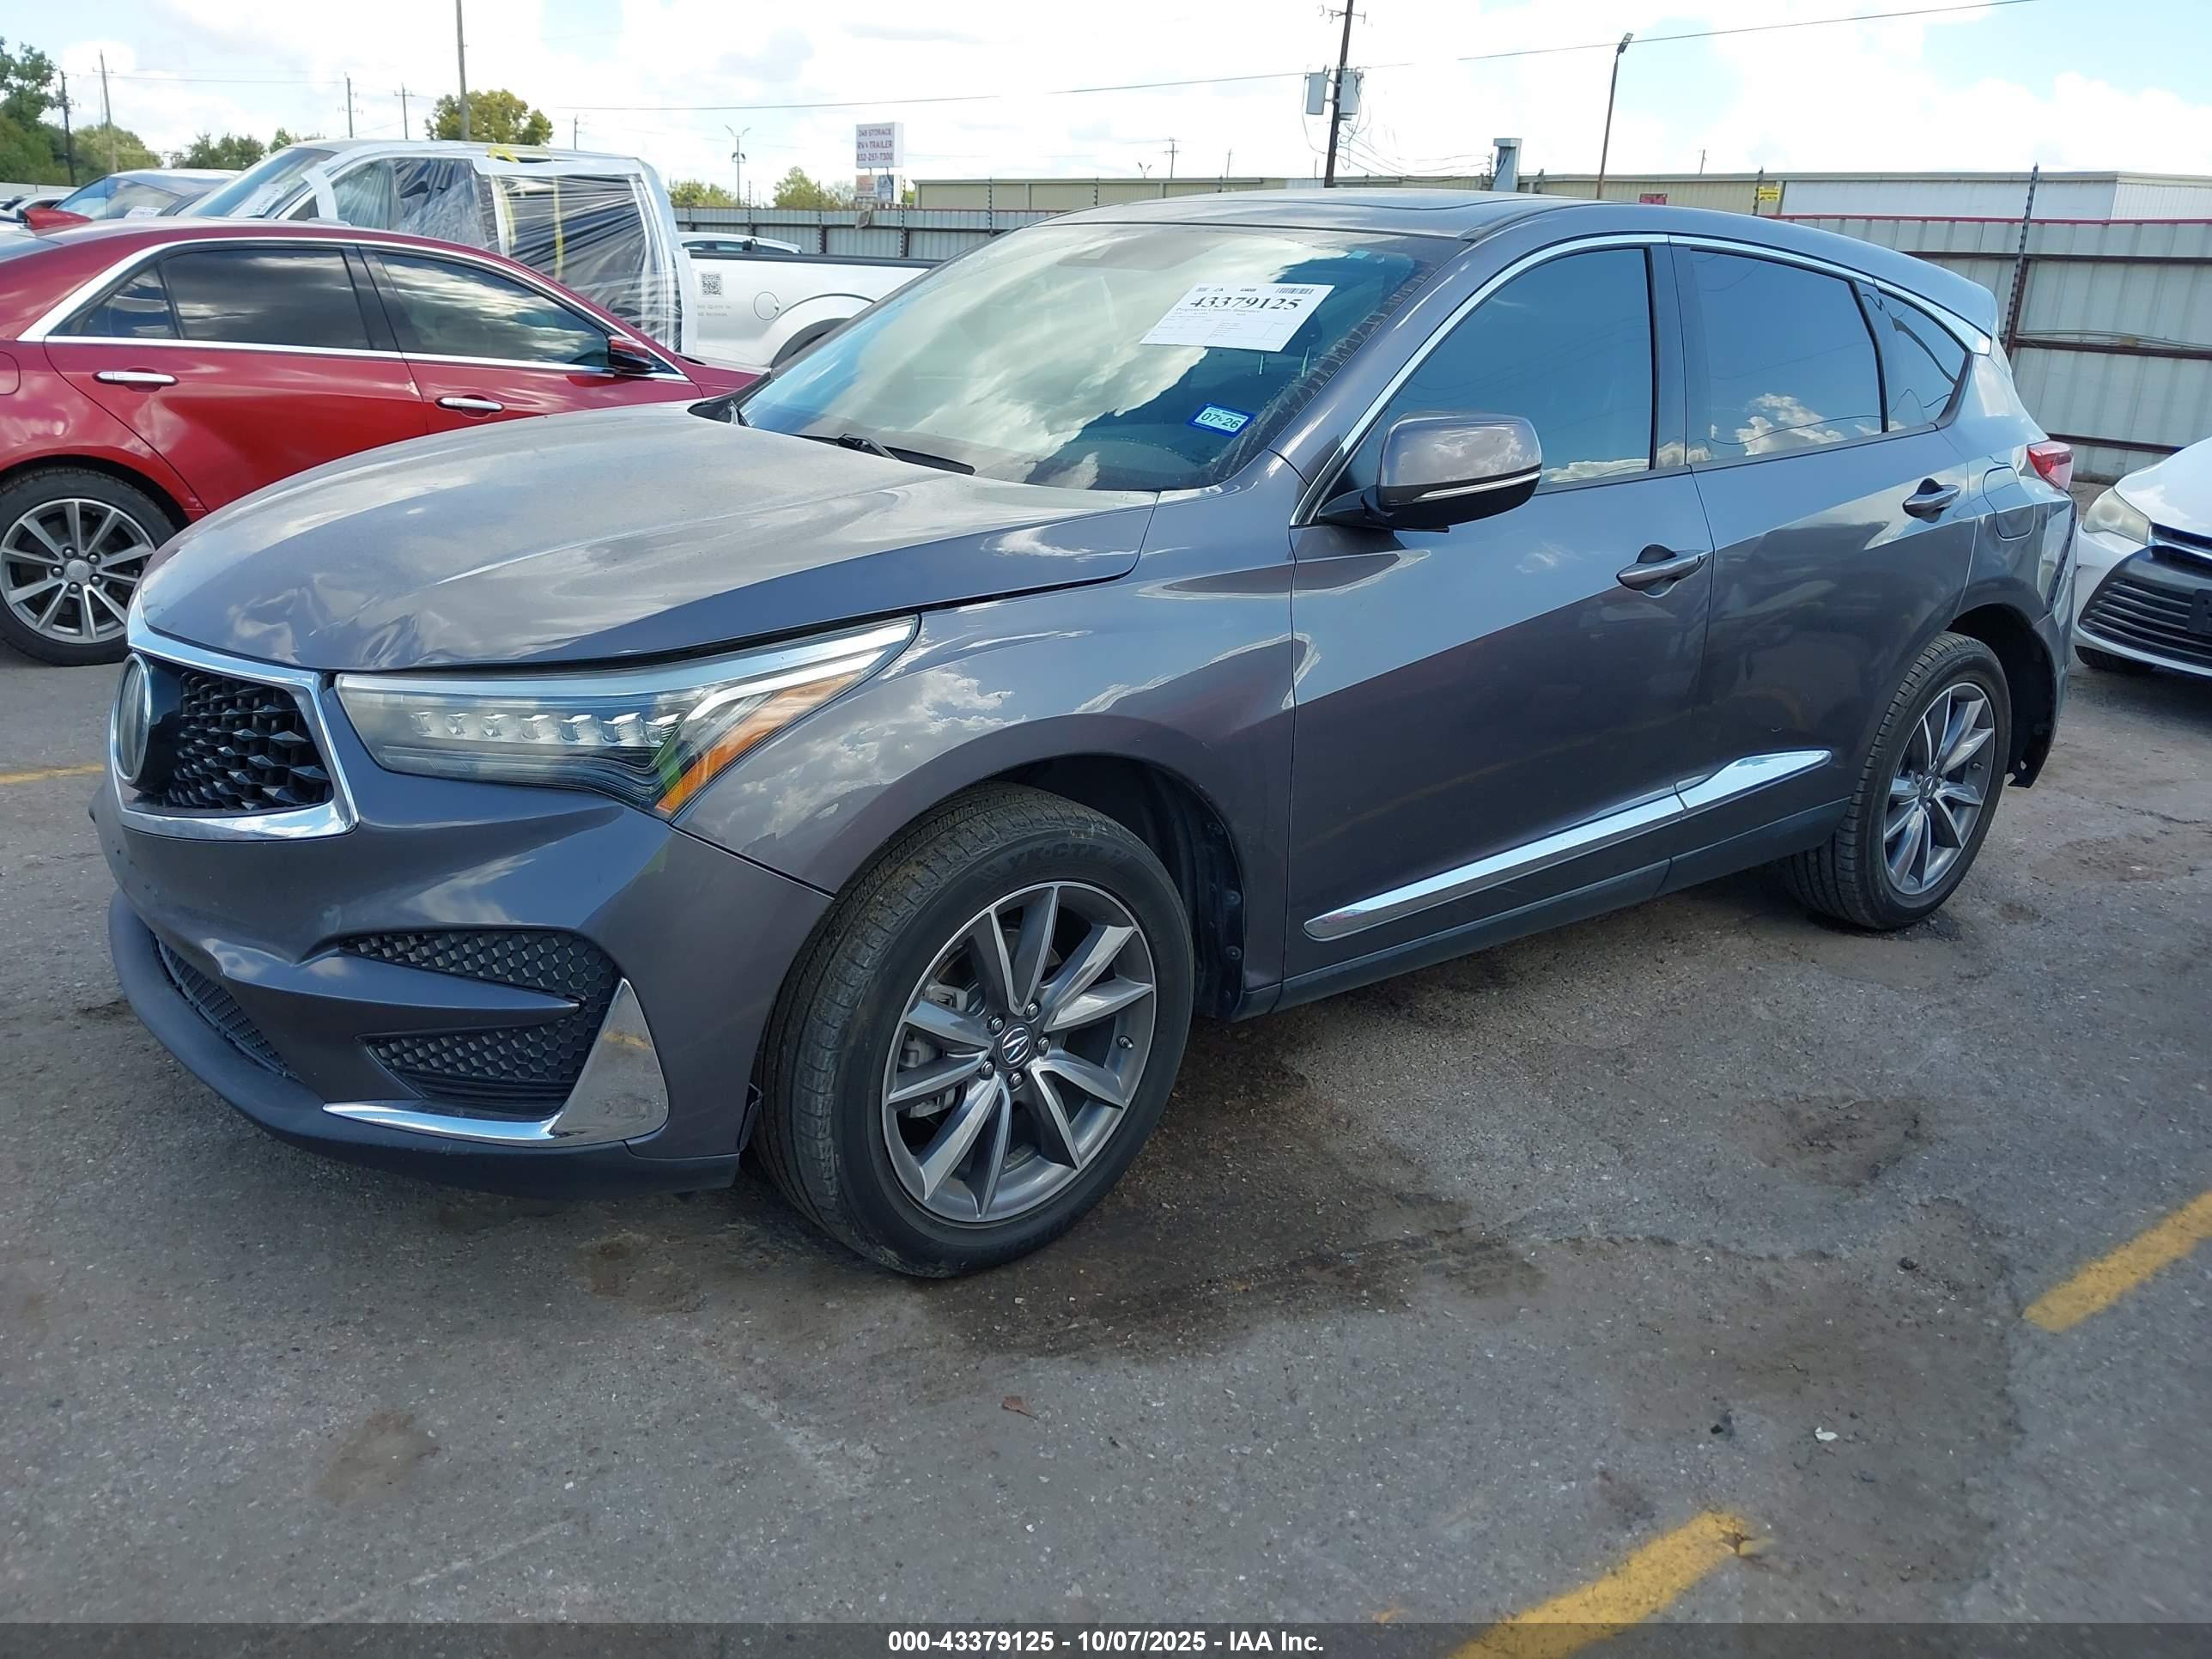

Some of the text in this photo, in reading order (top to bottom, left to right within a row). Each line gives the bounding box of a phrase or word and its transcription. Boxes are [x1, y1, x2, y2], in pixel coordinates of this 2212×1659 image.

[869, 140, 892, 149] TRAILER
[1189, 296, 1304, 310] 43379125
[1201, 412, 1219, 422] 07
[1222, 417, 1241, 428] 26
